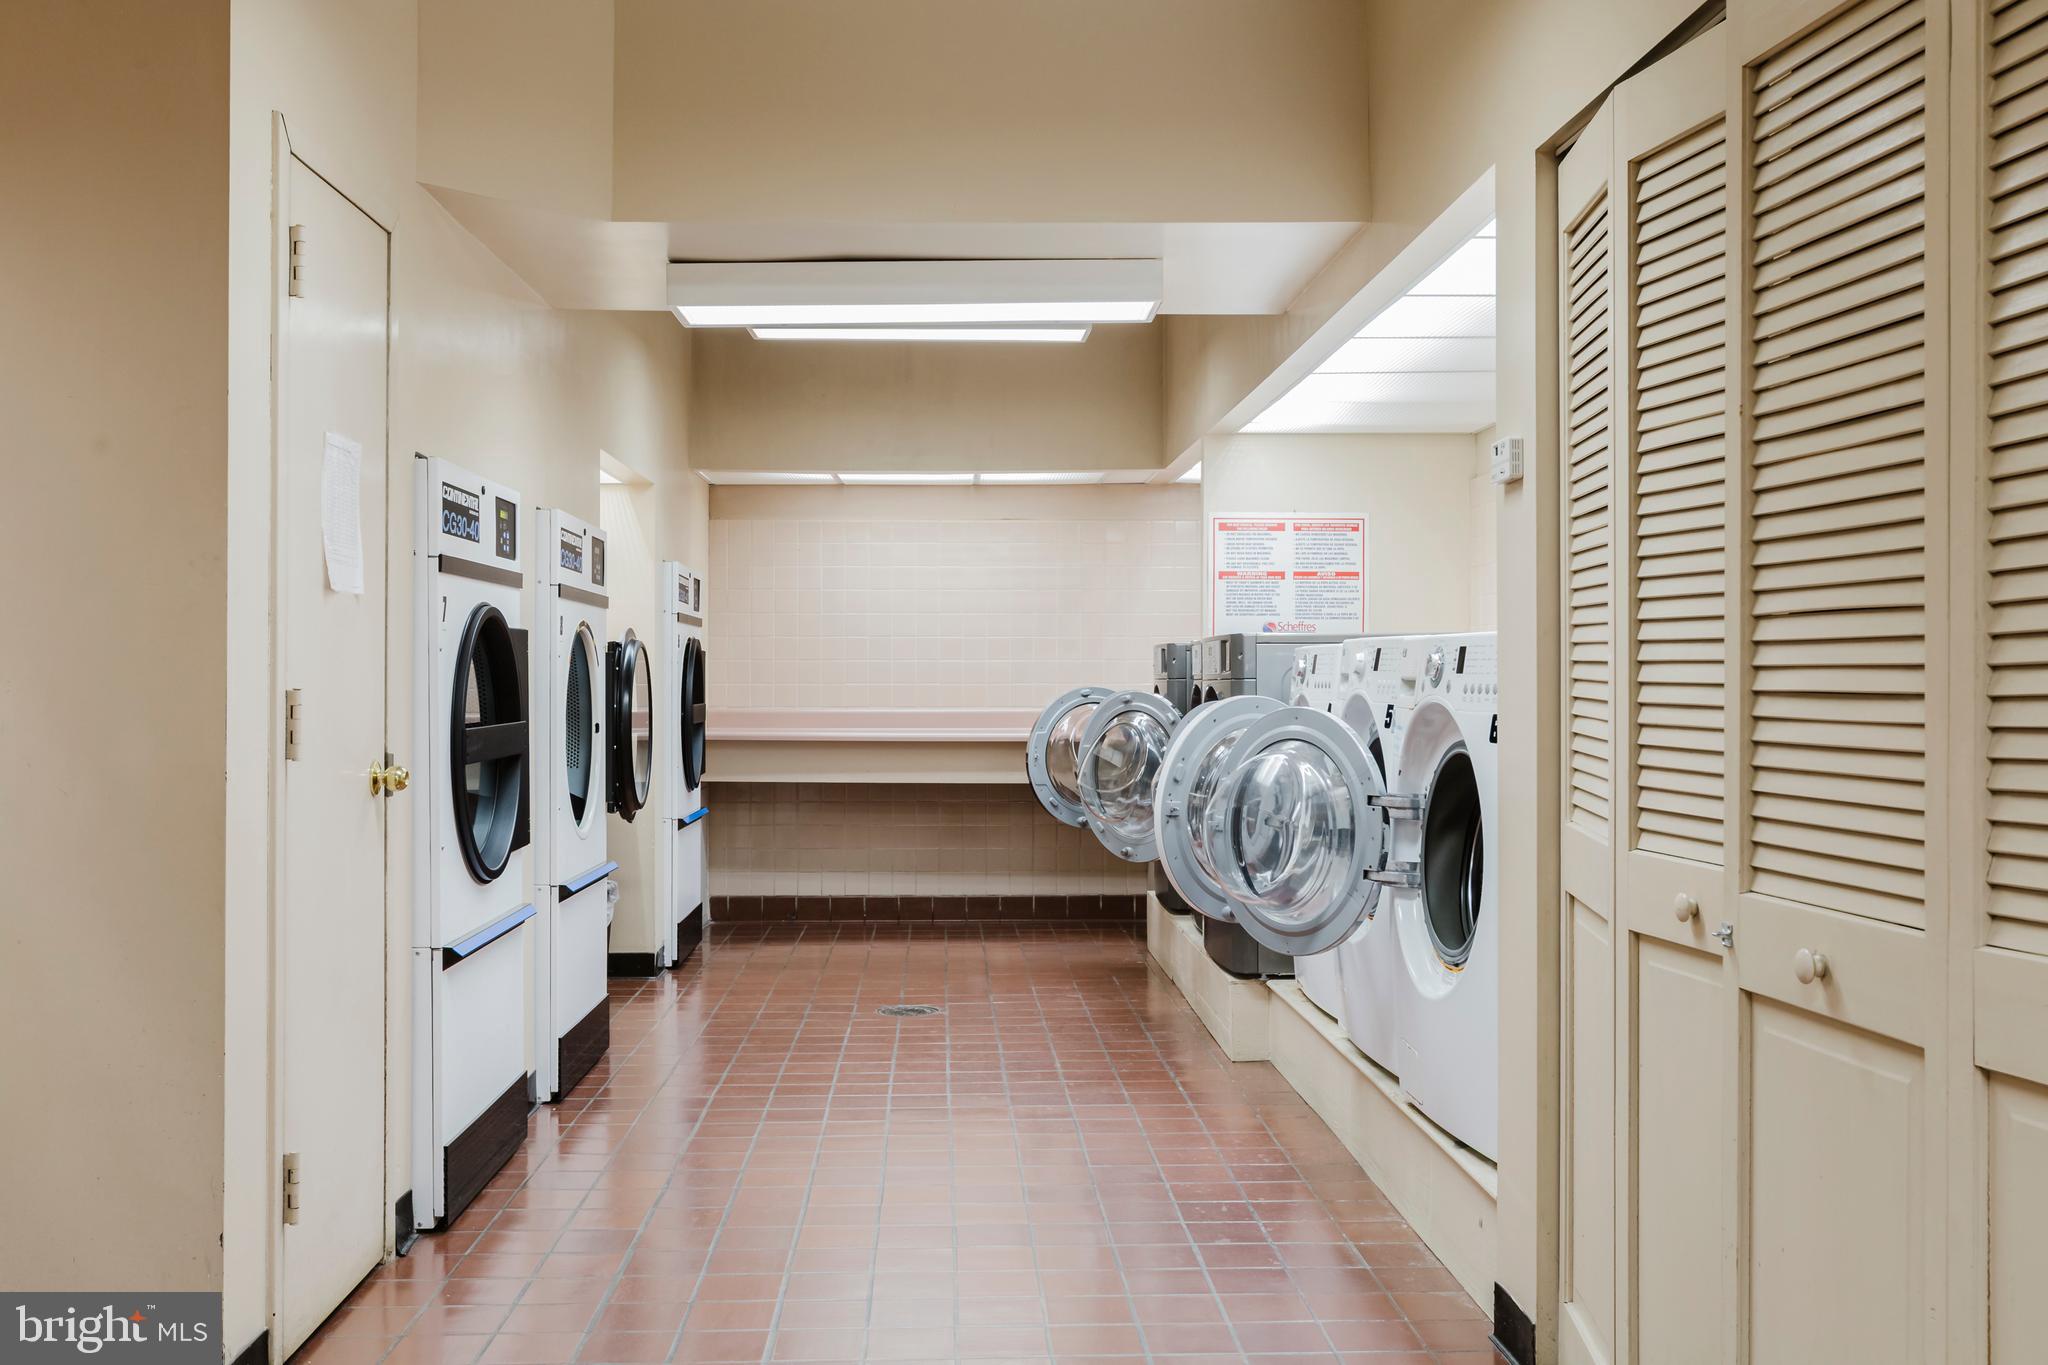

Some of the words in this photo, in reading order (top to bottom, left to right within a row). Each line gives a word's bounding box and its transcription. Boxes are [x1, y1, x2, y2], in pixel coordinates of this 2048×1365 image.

[442, 508, 480, 541] CG30-40
[442, 595, 447, 622] 7
[1277, 621, 1317, 633] Scheffres
[1384, 704, 1395, 729] 5
